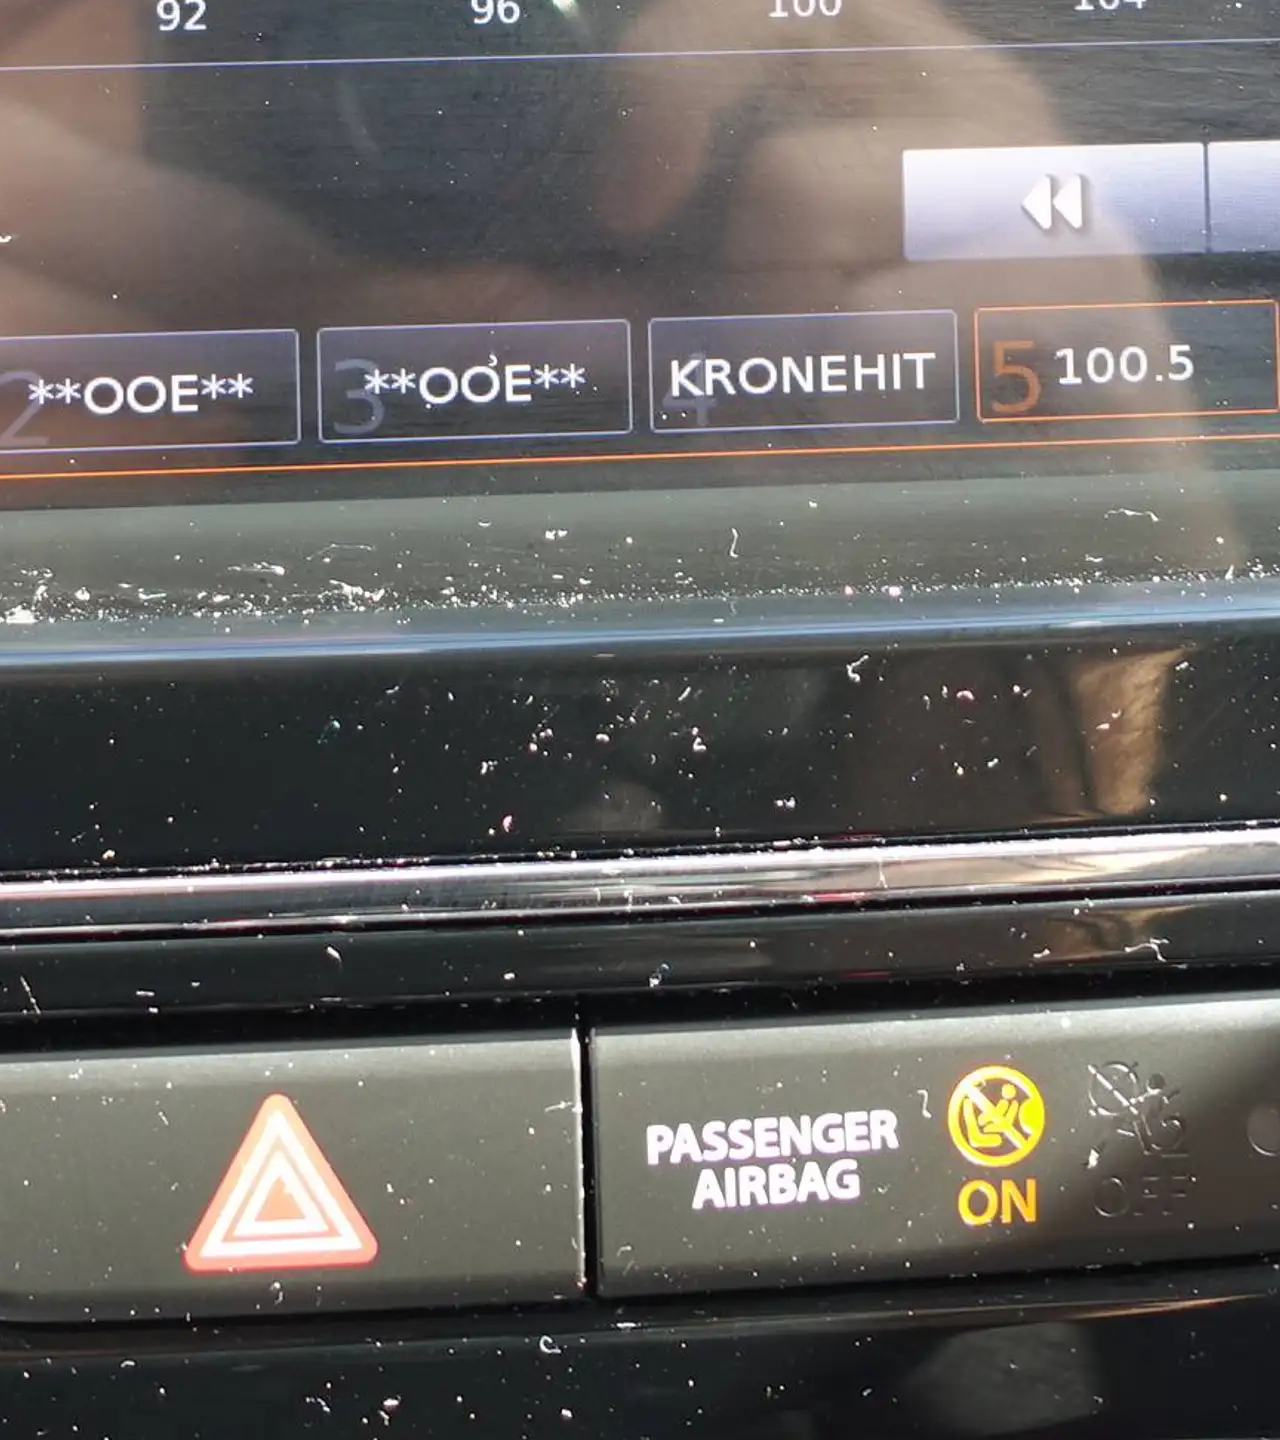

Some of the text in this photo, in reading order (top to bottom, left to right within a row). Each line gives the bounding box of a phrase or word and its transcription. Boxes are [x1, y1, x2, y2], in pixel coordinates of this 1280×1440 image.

[670, 352, 937, 398] KRONEHIT
[991, 340, 1042, 414] 5
[1055, 344, 1195, 386] 100.5
[333, 359, 385, 435] 3
[647, 1108, 899, 1165] PASSENGER
[692, 1158, 862, 1212] AIRBAG
[957, 1178, 1038, 1227] ON
